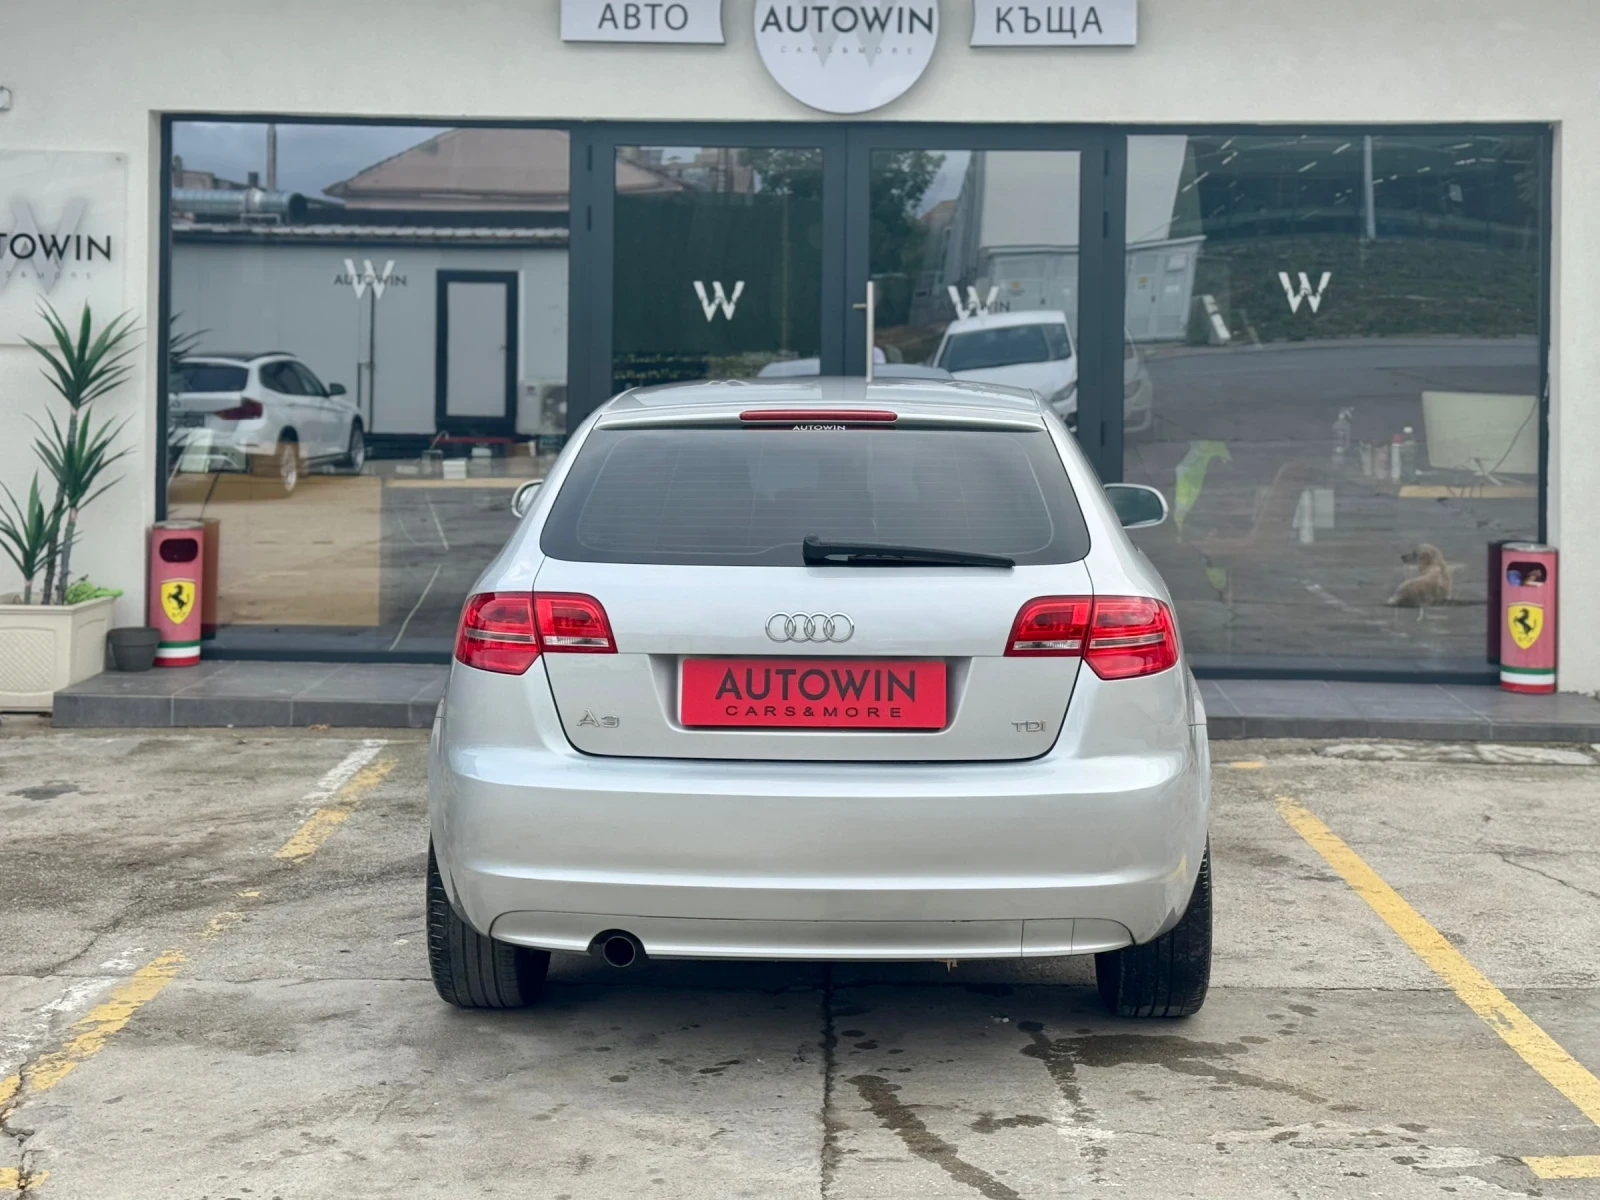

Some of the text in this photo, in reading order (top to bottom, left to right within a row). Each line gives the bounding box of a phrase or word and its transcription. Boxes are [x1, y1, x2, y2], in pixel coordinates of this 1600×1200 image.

[597, 2, 689, 30] АВТО
[760, 5, 934, 34] AUTOWIN
[995, 6, 1102, 39] КЪЩА
[715, 667, 916, 702] AUTOWIN
[576, 708, 620, 729] A3
[725, 705, 902, 718] CARS&MORE
[1011, 719, 1047, 732] TDI
